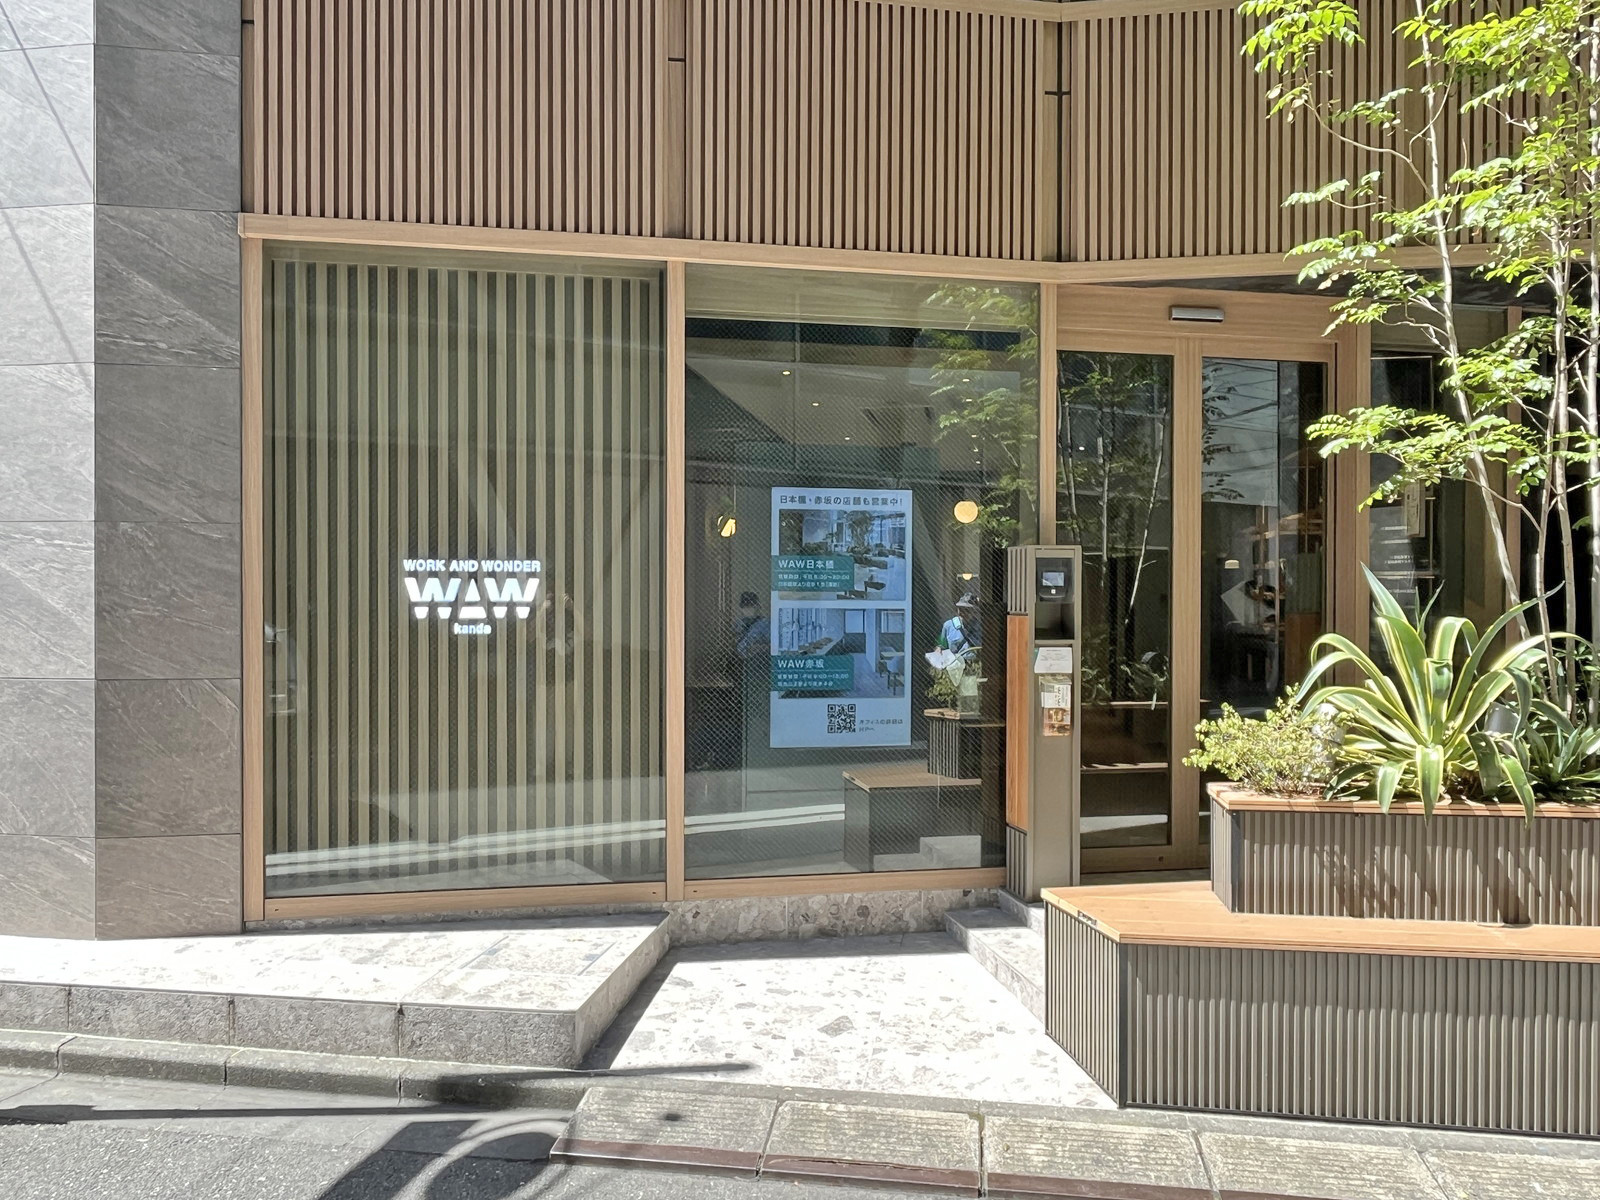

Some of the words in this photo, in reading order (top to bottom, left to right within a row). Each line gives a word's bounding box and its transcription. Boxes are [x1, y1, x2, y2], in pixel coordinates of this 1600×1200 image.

[403, 559, 446, 572] WORK
[449, 560, 479, 572] AND
[481, 560, 541, 573] WONDER
[404, 577, 540, 620] WAW
[454, 622, 492, 635] kanda
[777, 658, 825, 669] WAW赤坂
